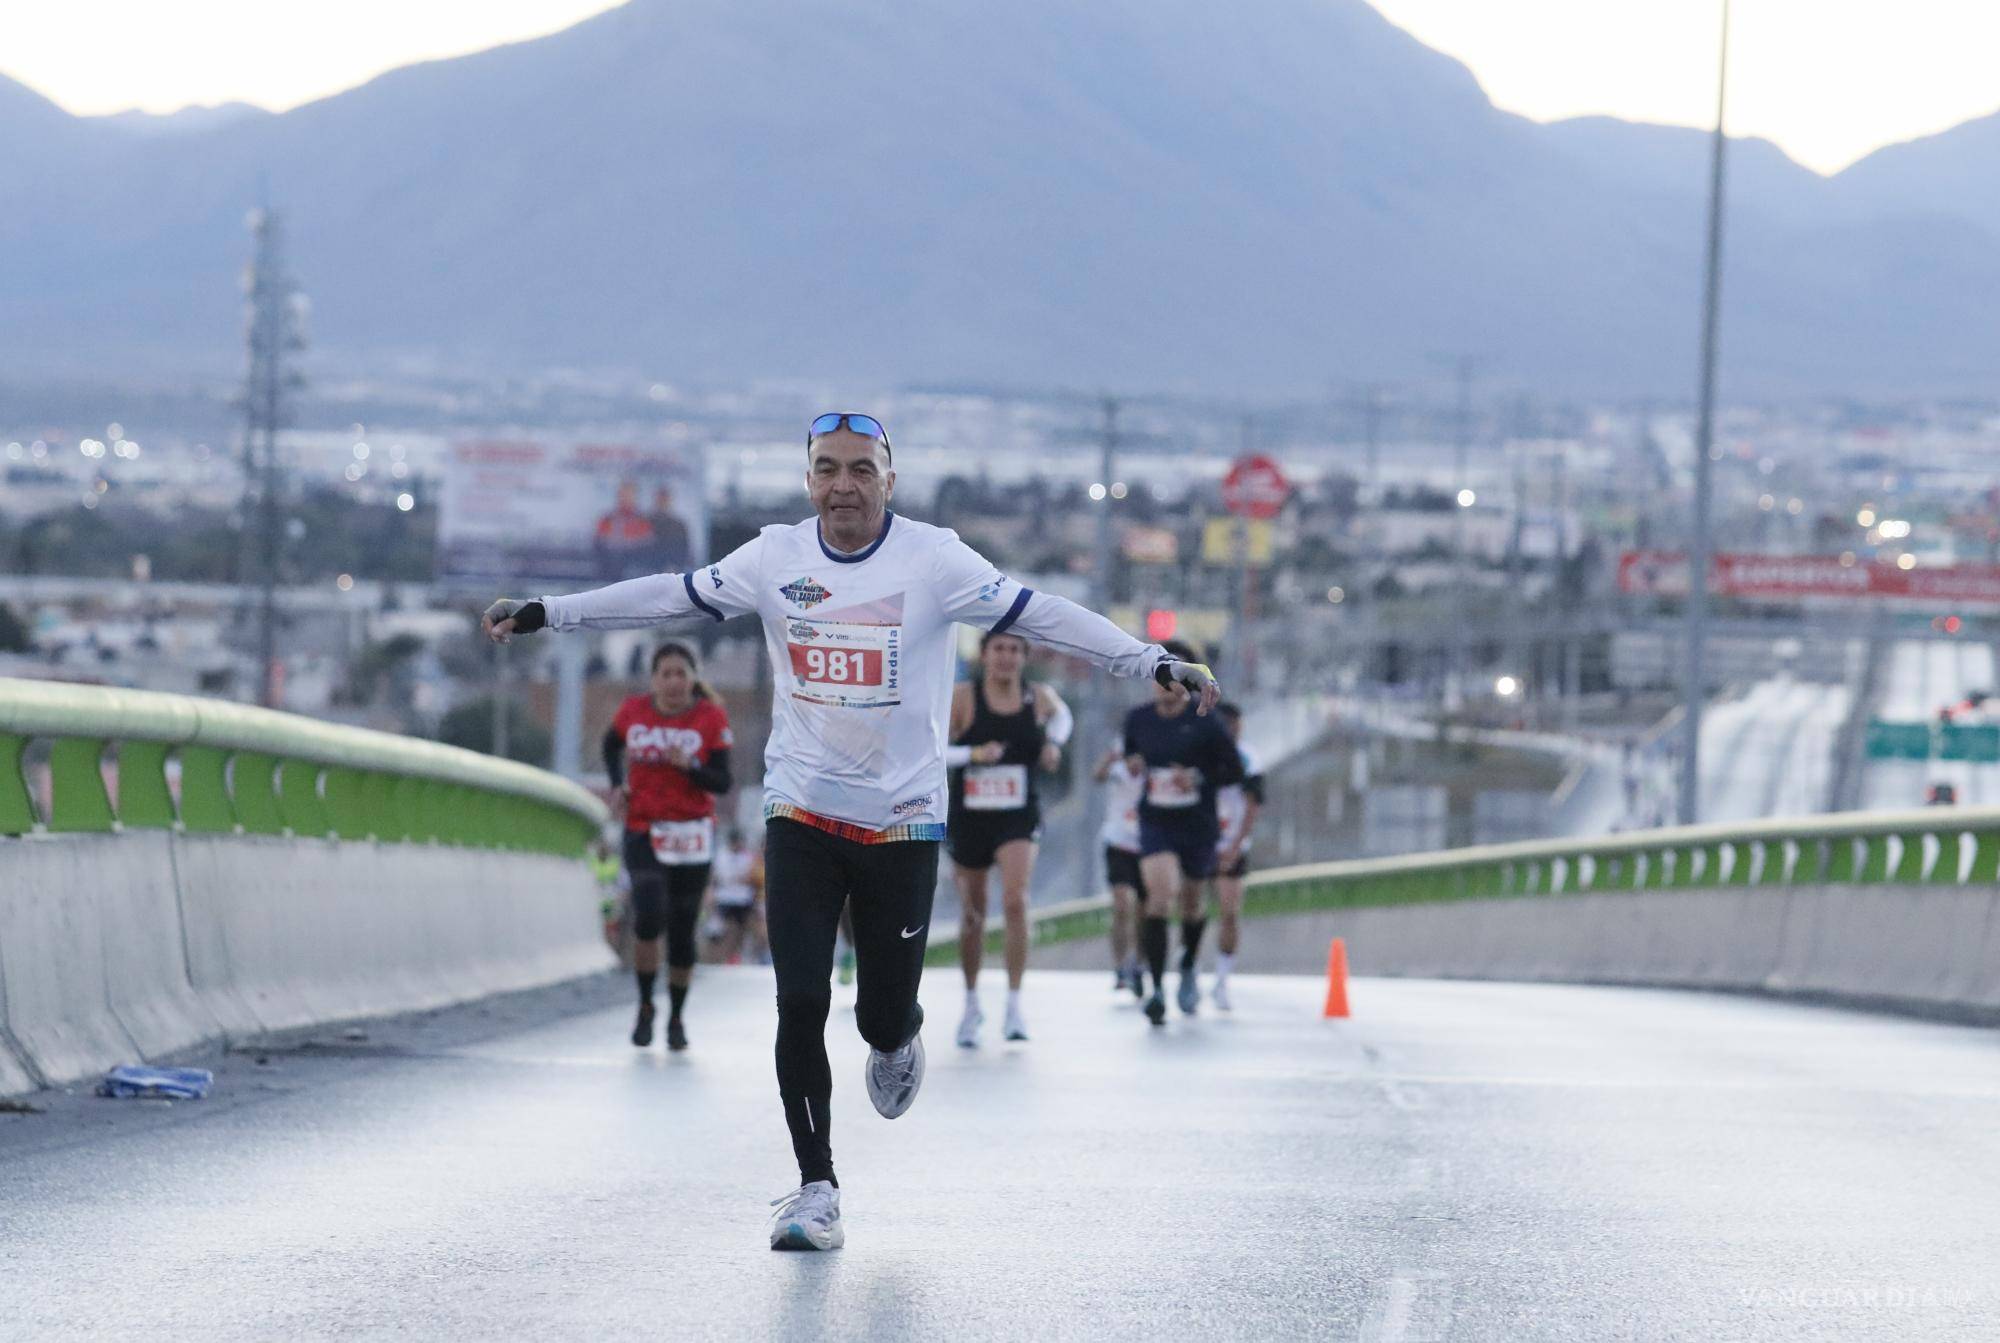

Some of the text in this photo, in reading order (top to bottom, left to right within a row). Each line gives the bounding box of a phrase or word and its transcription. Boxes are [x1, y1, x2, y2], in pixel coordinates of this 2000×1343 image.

[785, 590, 797, 600] DEL
[806, 649, 865, 683] 981
[887, 629, 898, 689] Medalla
[902, 796, 933, 809] CHRONO
